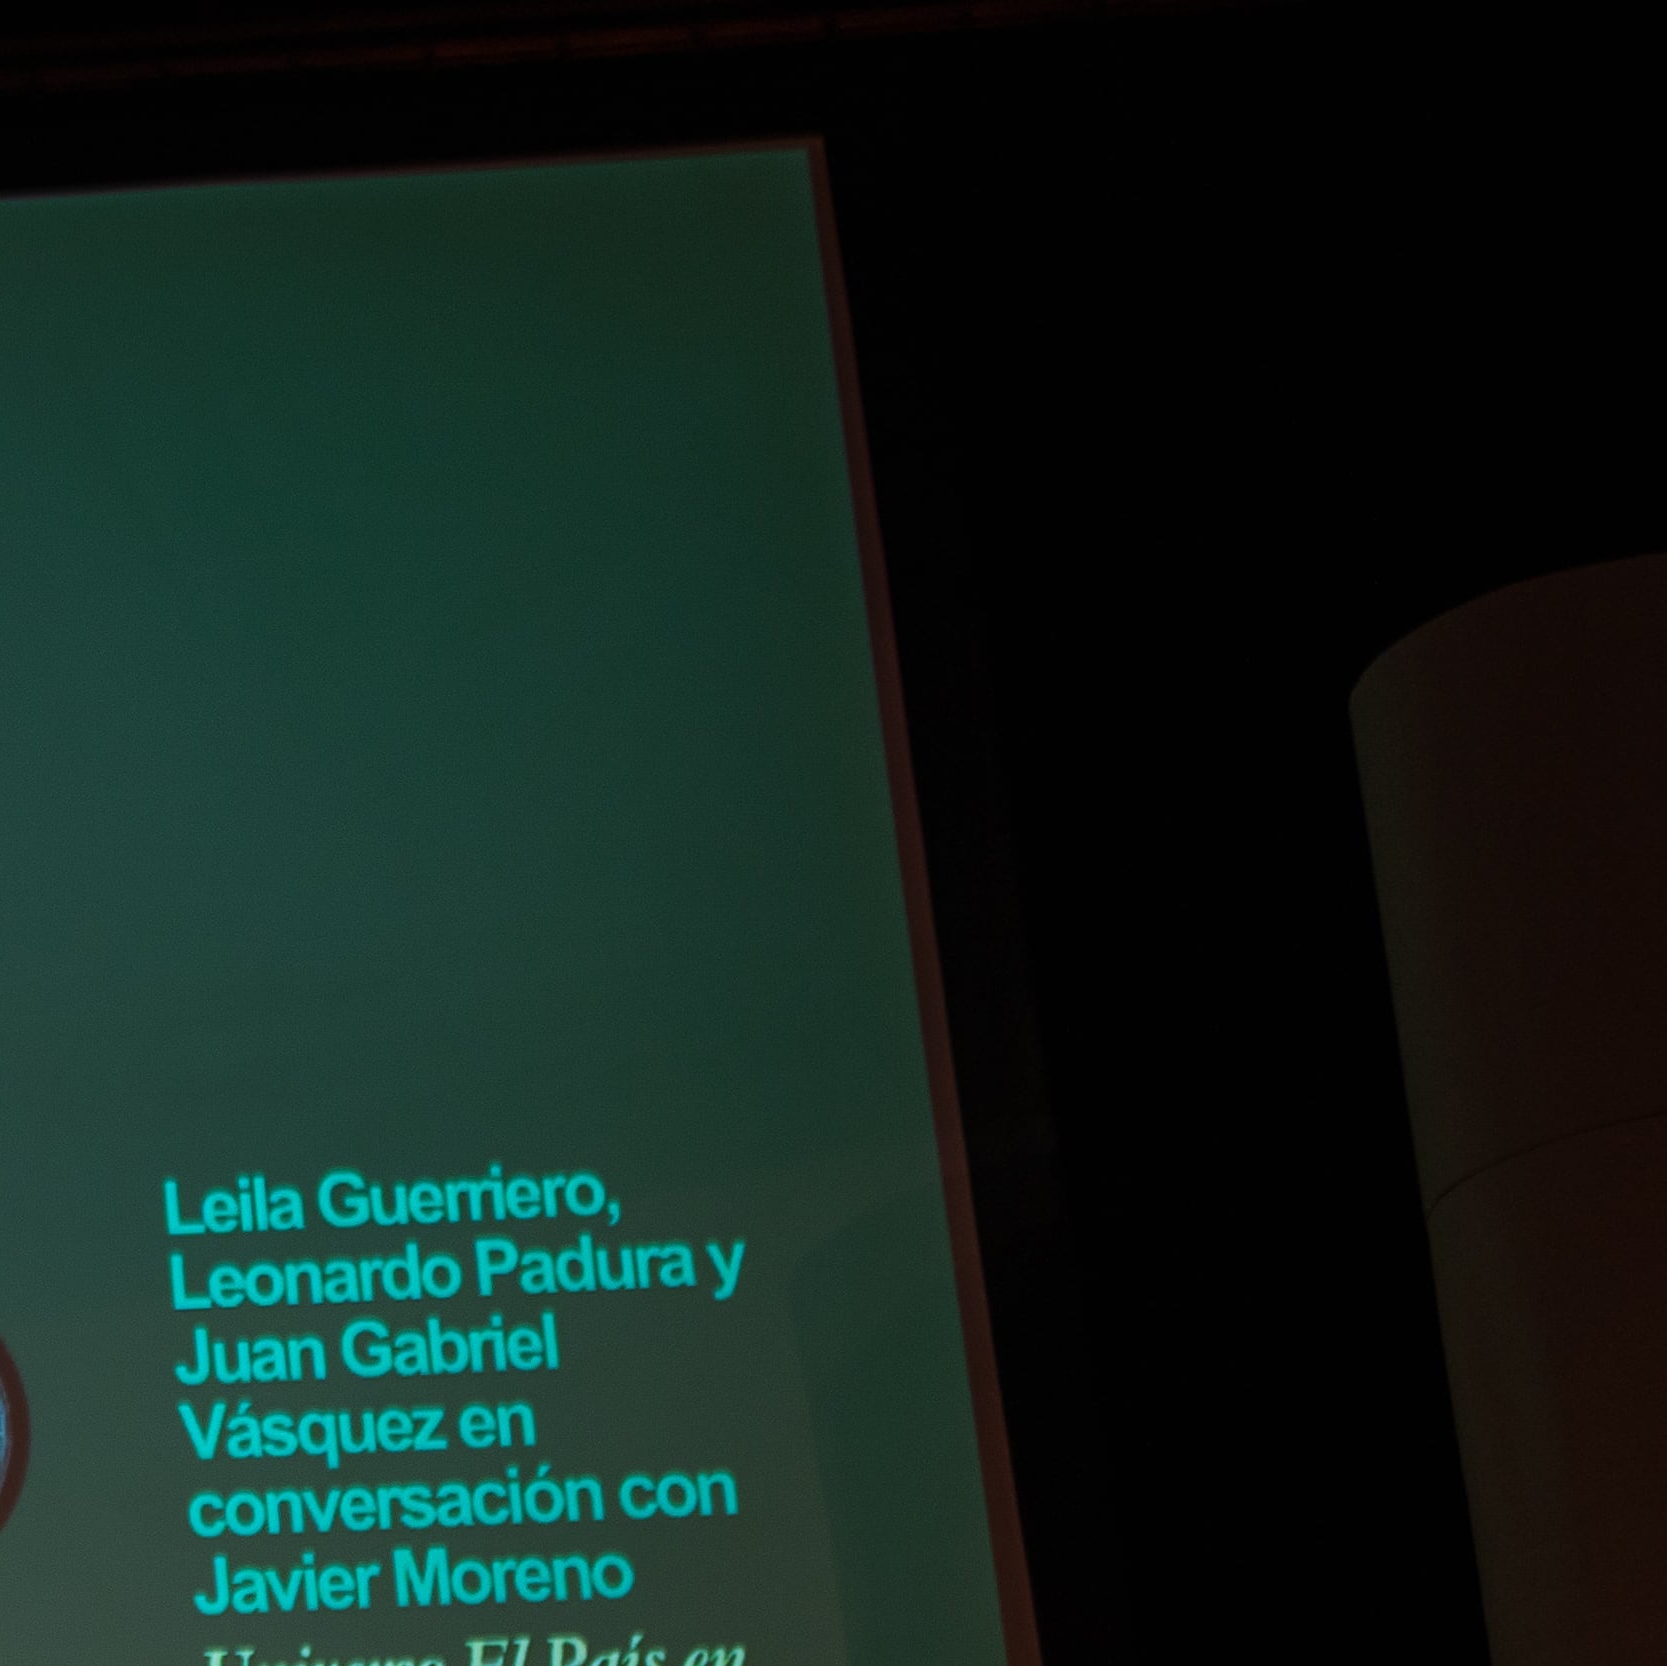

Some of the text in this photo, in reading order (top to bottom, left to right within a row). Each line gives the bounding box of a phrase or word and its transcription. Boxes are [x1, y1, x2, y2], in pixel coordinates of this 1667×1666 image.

[163, 1163, 621, 1236] Leila Guerriero,
[168, 1233, 745, 1310] Leonardo Padura y
[174, 1311, 559, 1386] Juan Gabriel
[177, 1400, 536, 1469] Vásquez en
[187, 1464, 738, 1538] conversación con
[193, 1545, 635, 1616] Javier Moreno
